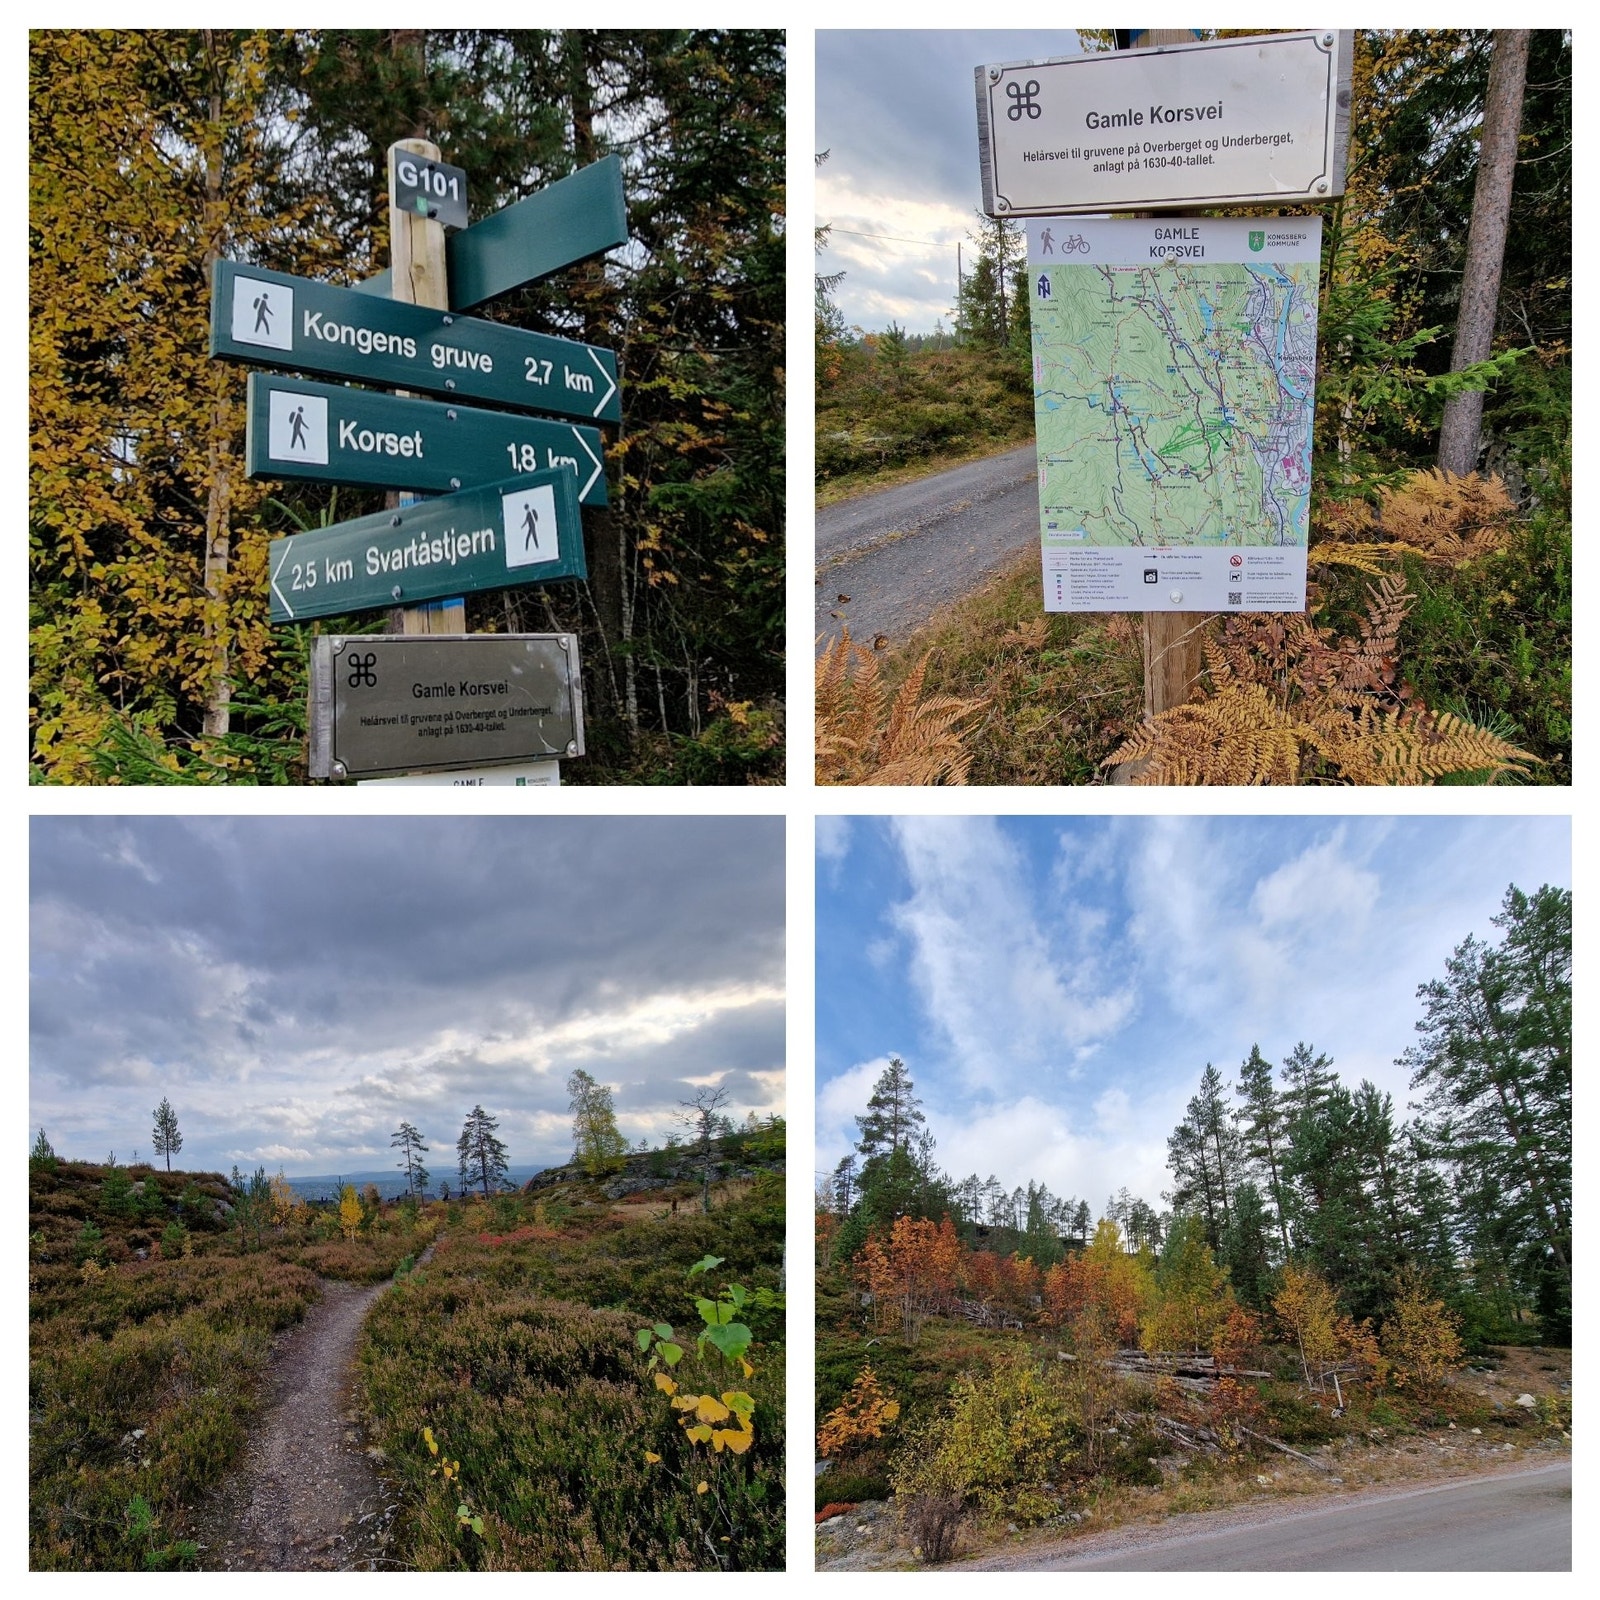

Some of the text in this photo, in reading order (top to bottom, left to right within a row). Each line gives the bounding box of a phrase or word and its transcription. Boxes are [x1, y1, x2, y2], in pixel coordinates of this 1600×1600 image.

[1086, 101, 1224, 130] Gamle Korsvei
[1023, 132, 1294, 162] Helårsvei til gruvene på Overberget og Underberget,
[1093, 154, 1215, 174] anlagt på 1630-40-tallet.
[398, 161, 459, 202] G101
[1154, 227, 1200, 240] GAMLE
[303, 310, 593, 394] Kongens gruve 2,7 km
[338, 419, 579, 477] Korset 1,8 km
[291, 526, 496, 591] 2,5 km Svartåstjern
[412, 680, 508, 698] Gamle Korsvei
[360, 714, 399, 727] Helårsvei
[410, 714, 442, 726] gruvene
[444, 711, 454, 724] på
[455, 709, 496, 721] Overberget
[498, 709, 508, 720] og
[418, 725, 442, 738] anlagt
[444, 724, 454, 737] på
